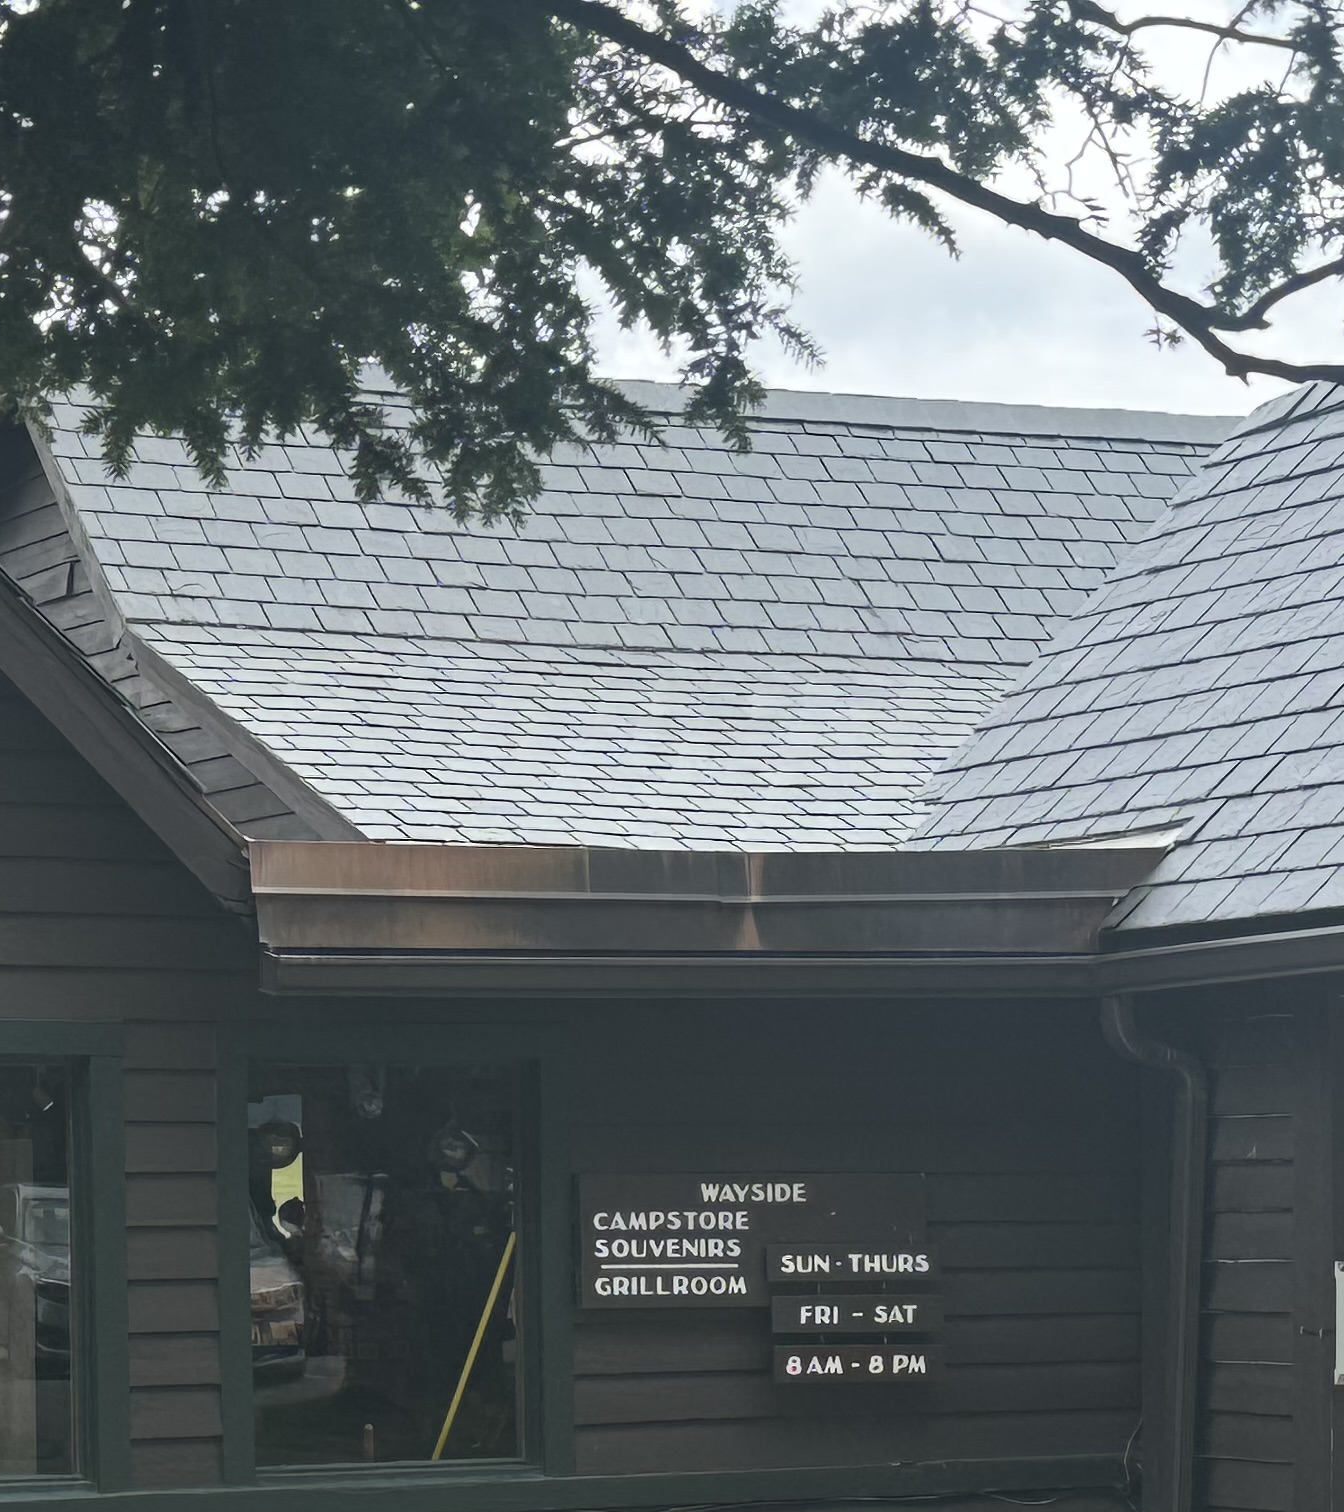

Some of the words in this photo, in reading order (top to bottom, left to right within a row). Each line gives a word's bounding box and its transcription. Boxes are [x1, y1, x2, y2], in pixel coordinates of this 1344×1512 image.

[700, 1182, 807, 1203] WAYSIDE
[592, 1210, 750, 1231] CAMPSTORE
[593, 1238, 742, 1258] SOUVENIRS
[780, 1253, 830, 1274] SUN
[847, 1253, 930, 1273] THURS
[594, 1275, 748, 1297] GRILLROOM
[799, 1305, 839, 1325] FRI
[873, 1304, 918, 1324] SAT
[868, 1354, 884, 1374] 8
[892, 1354, 926, 1374] PM
